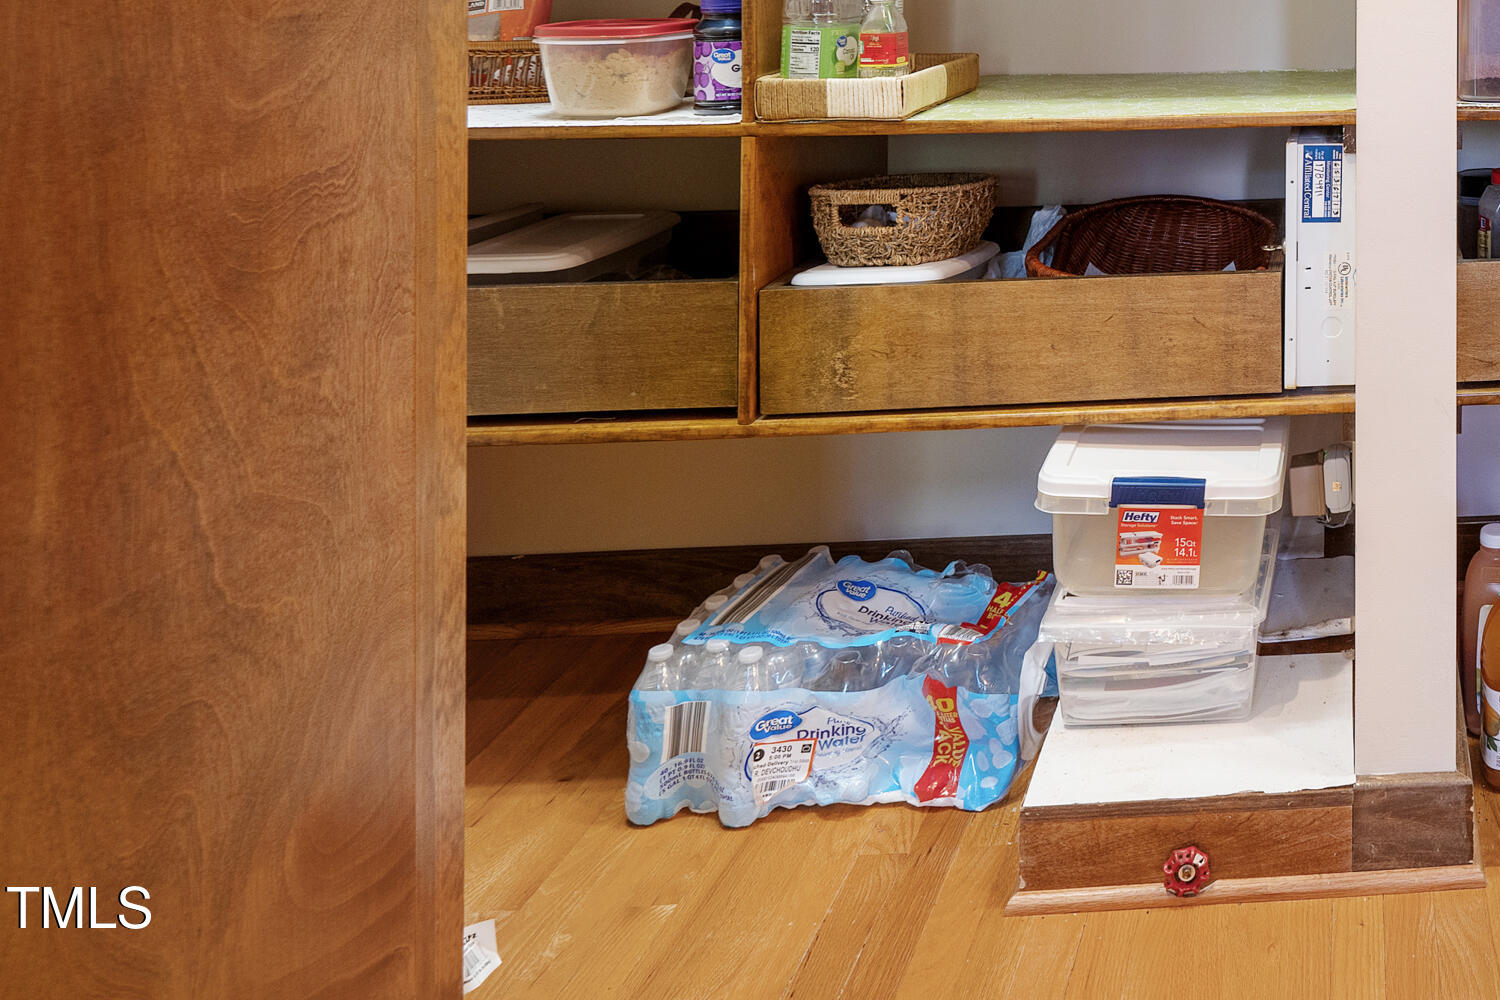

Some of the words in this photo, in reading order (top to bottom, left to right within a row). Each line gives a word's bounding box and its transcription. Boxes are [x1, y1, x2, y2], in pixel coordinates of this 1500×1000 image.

[1305, 160, 1313, 191] Affiliated
[1303, 192, 1312, 219] Central
[1124, 512, 1157, 523] Hefty
[1174, 548, 1198, 557] 14.1L
[842, 581, 871, 594] Great
[755, 715, 793, 732] Great
[764, 723, 793, 733] Value
[796, 725, 867, 739] Drinking
[818, 734, 866, 750] Water
[930, 729, 953, 768] ACK
